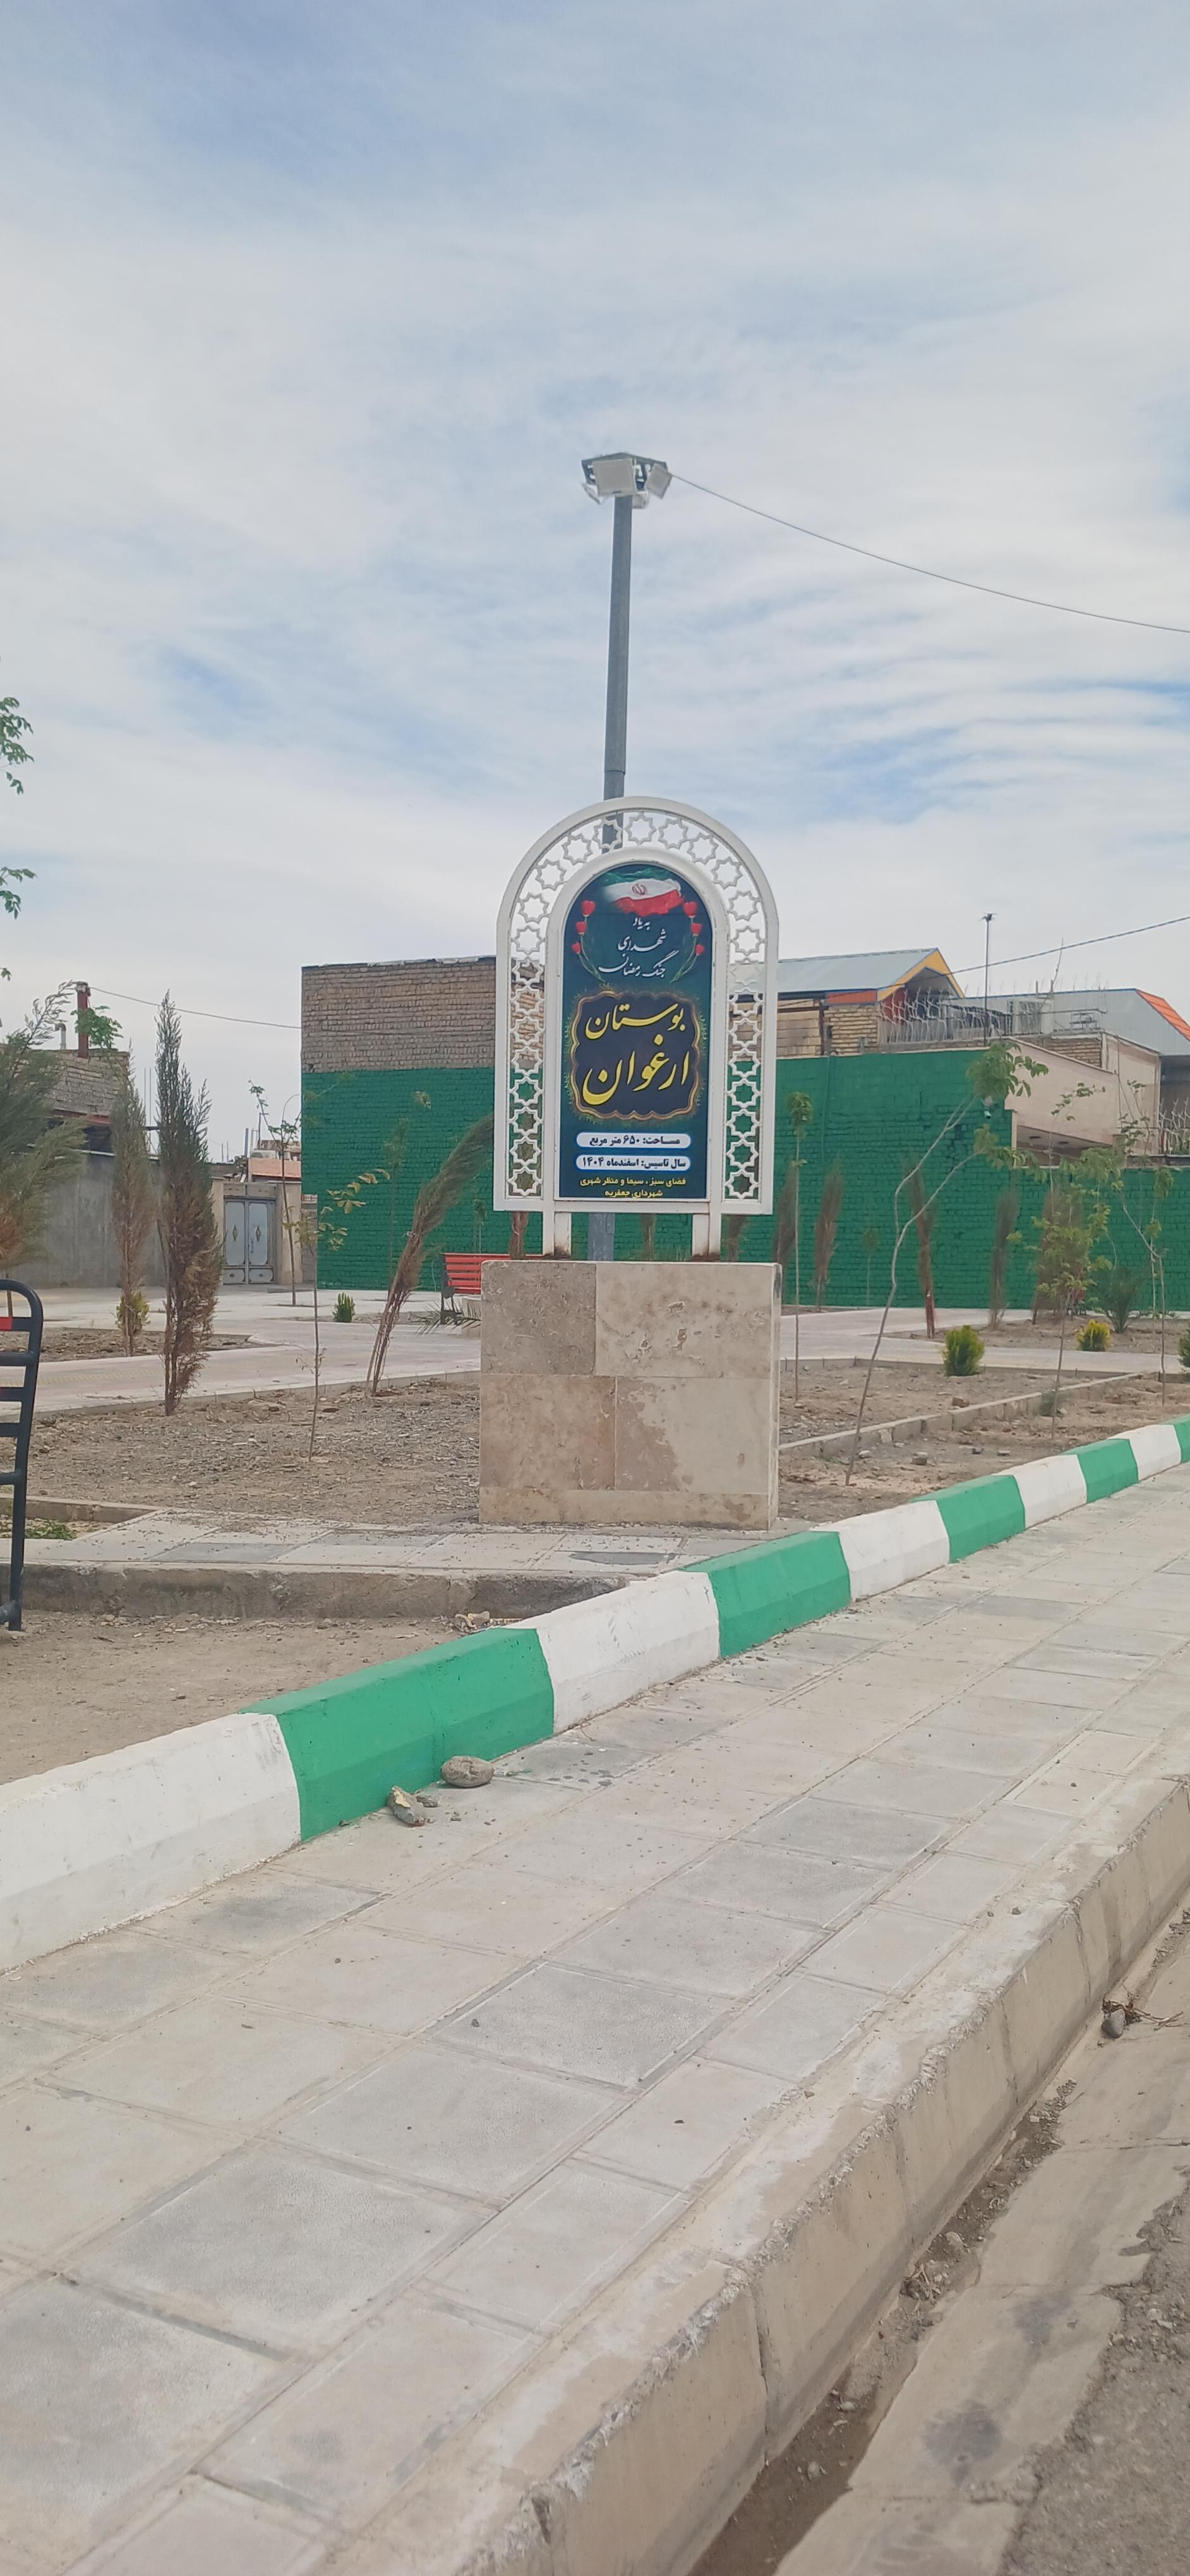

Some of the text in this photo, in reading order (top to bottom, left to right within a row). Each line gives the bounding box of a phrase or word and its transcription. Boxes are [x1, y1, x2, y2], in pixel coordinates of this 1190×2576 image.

[617, 929, 666, 952] شهدای
[598, 950, 680, 977] جنگ رمضان
[585, 1003, 686, 1040] بوستان
[582, 1034, 690, 1106] ارغوان
[589, 1136, 607, 1146] مربع
[610, 1136, 622, 1147] متر
[623, 1135, 640, 1145] ۶۵۰
[582, 1156, 604, 1167] ۱۴۰۴
[606, 1157, 639, 1167] اسفندماه
[670, 1158, 686, 1169] سال
[579, 1177, 601, 1187] شهری
[602, 1177, 619, 1186] منظر
[627, 1177, 644, 1185] سیما
[649, 1178, 664, 1187] سبز
[665, 1178, 687, 1187] فضای
[604, 1188, 663, 1198] شهرداری جعفریه
